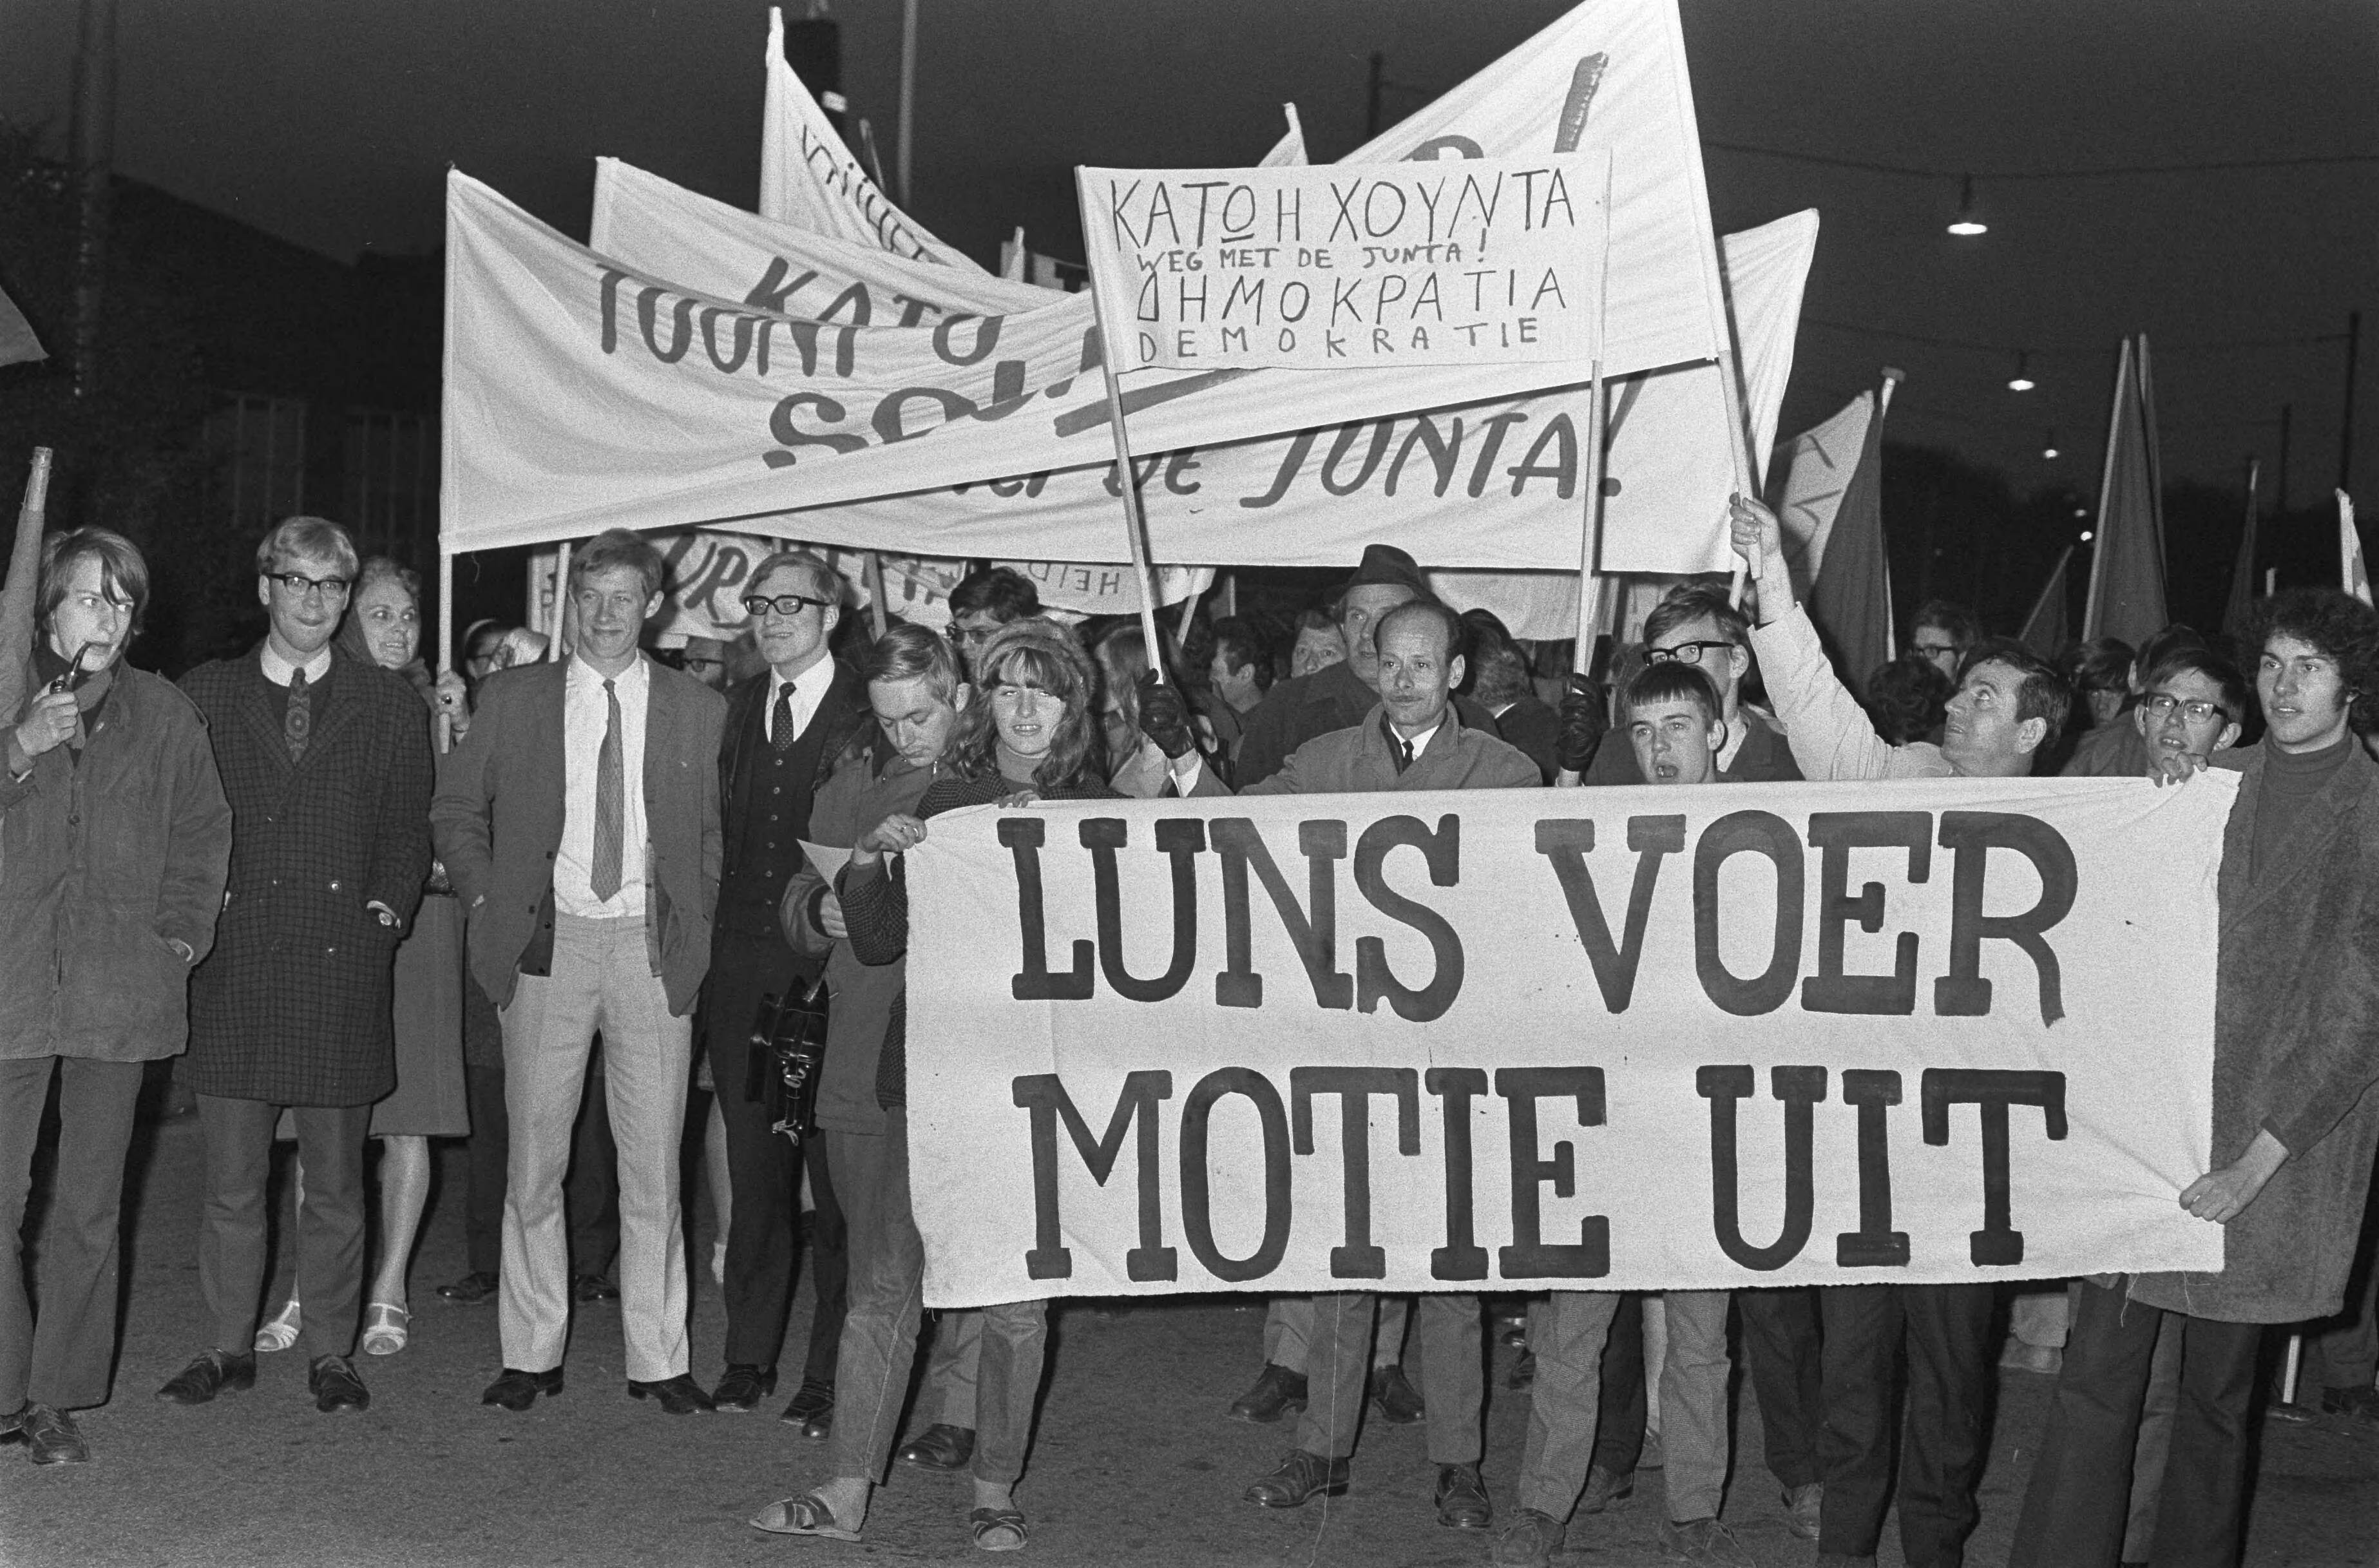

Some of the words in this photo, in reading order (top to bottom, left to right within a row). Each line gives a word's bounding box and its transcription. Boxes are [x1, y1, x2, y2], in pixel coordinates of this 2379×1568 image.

[1137, 249, 1203, 273] WEG
[1220, 247, 1279, 269] MET
[1299, 247, 1334, 269] DE
[1138, 317, 1538, 362] DEMOKRATIE
[997, 813, 1464, 1022] LUNS
[1534, 809, 2078, 1029] VOER
[1012, 1066, 1610, 1283] MOTIE
[1696, 1064, 2068, 1272] UIT
